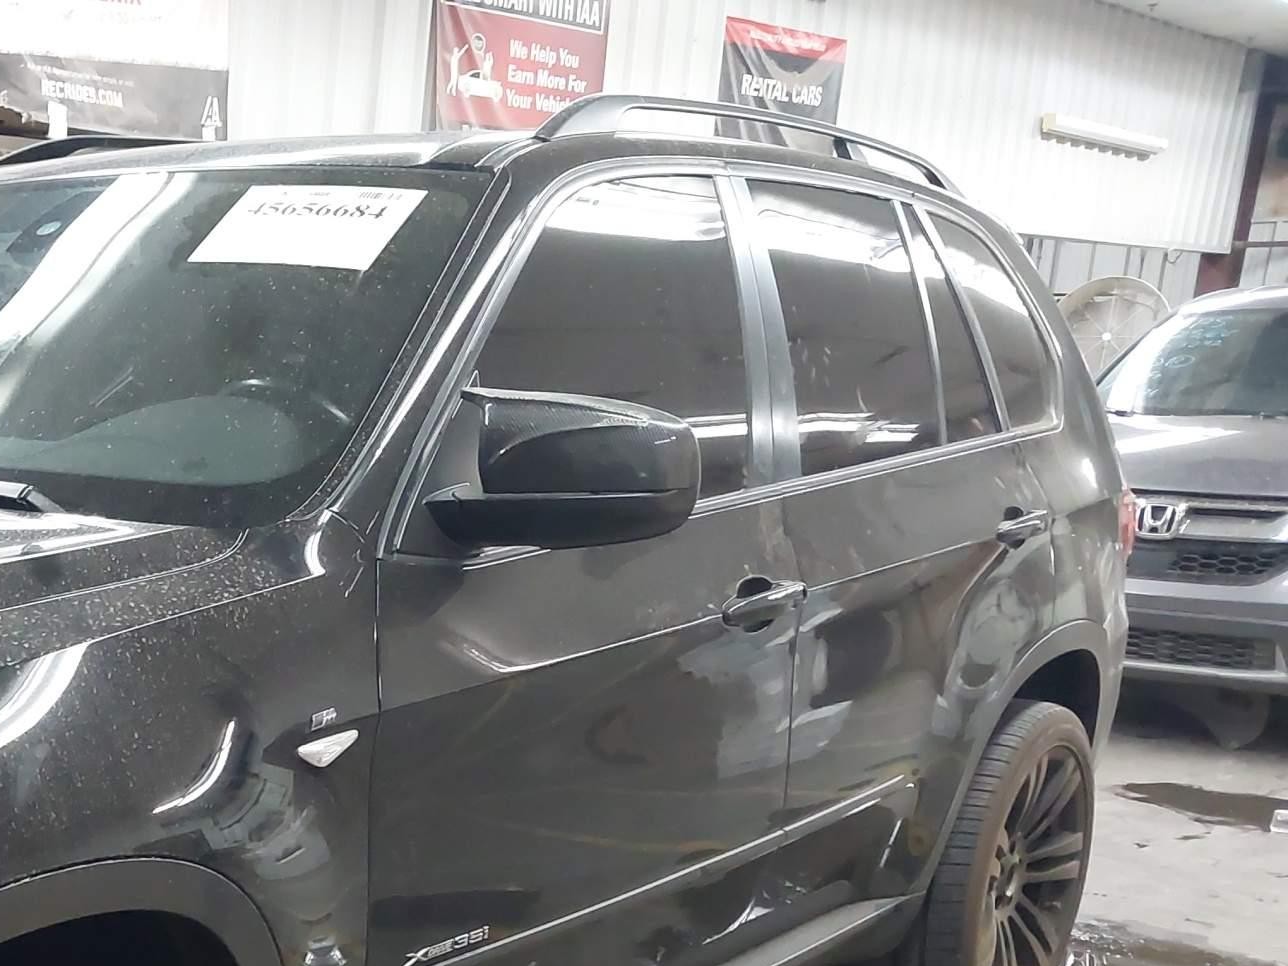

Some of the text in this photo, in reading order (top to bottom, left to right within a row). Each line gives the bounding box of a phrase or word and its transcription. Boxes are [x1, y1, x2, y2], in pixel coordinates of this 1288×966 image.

[537, 0, 574, 21] WITH
[576, 0, 601, 27] IAA
[509, 39, 579, 69] We Help You
[508, 64, 587, 94] Earn More For
[741, 74, 823, 107] RENTAL CARS
[505, 88, 571, 113] Your Vehic
[248, 202, 388, 219] 45656684
